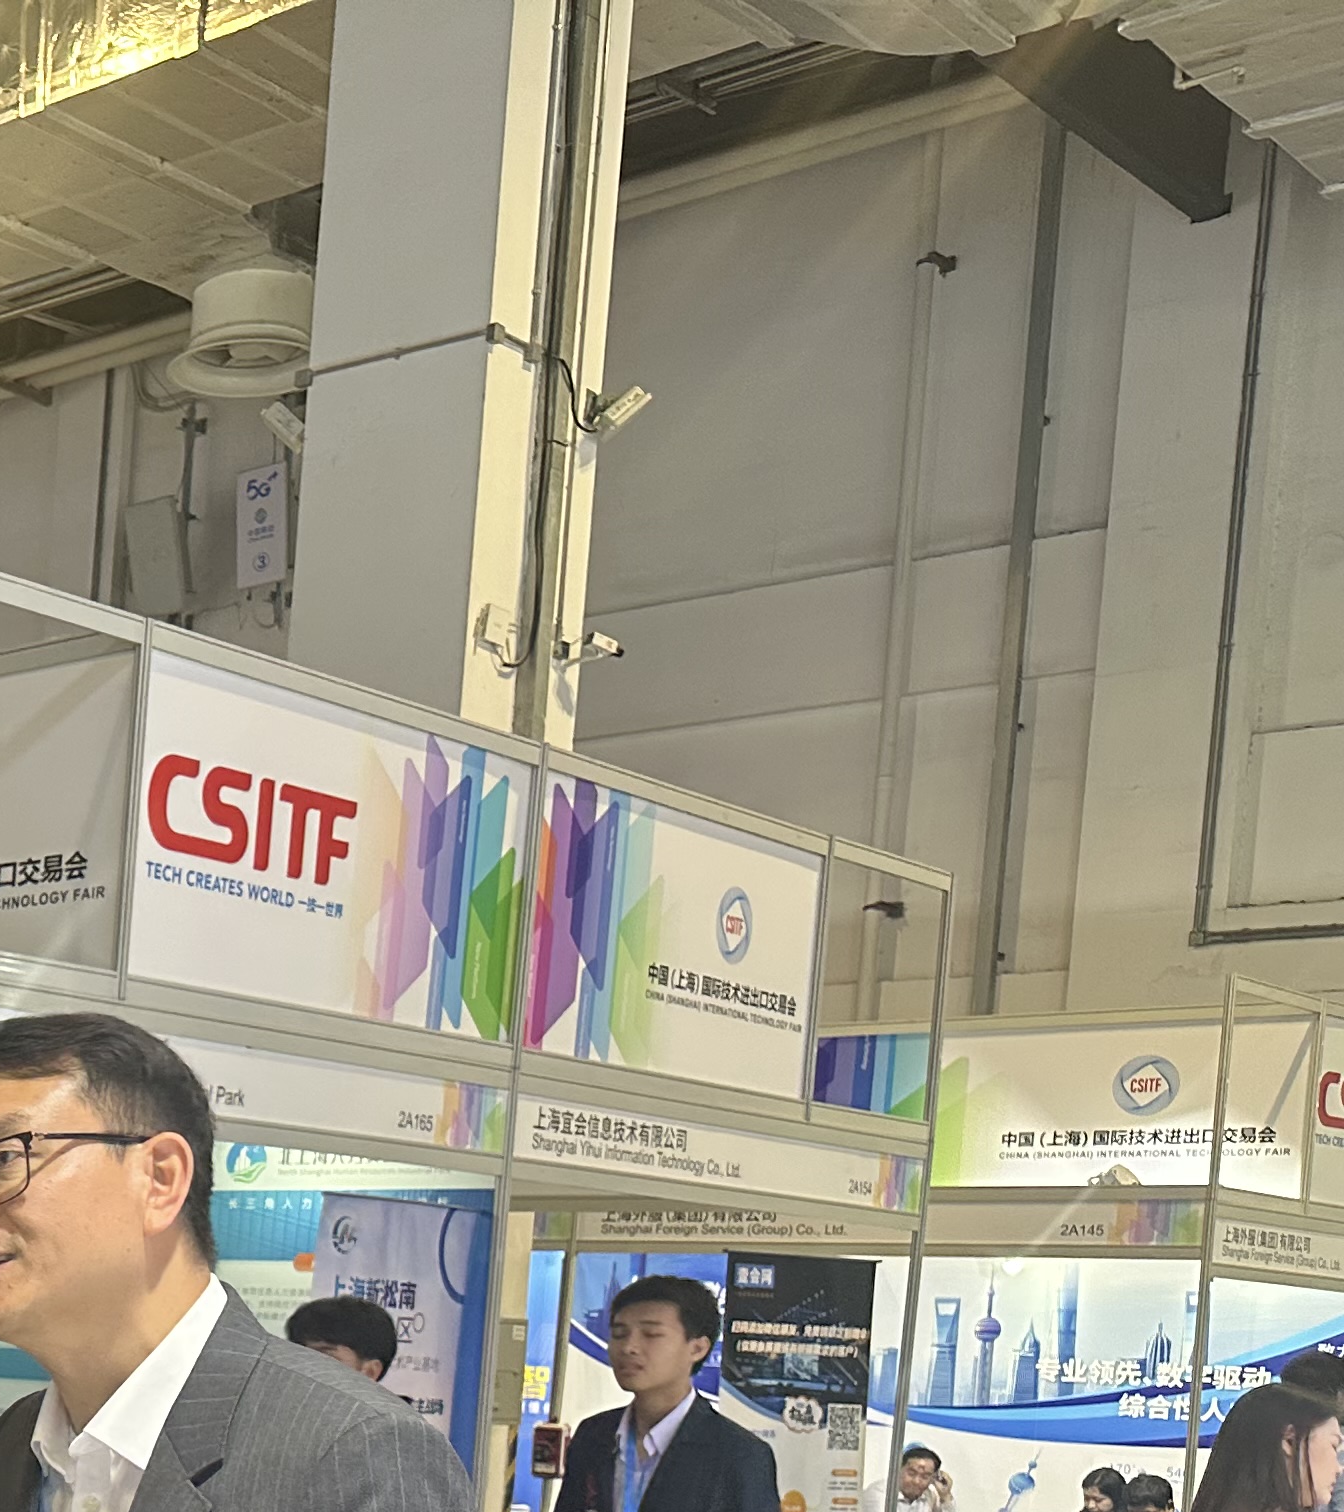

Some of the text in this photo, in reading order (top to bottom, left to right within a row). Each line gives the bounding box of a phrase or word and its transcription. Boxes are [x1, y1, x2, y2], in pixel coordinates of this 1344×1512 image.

[147, 754, 358, 886] CSITF
[72, 885, 106, 901] FAIR
[146, 861, 295, 908] TECH CREATES WORLD
[1129, 1077, 1163, 1095] CSITF
[215, 1088, 245, 1108] Park
[398, 1111, 434, 1132] 2A165
[533, 1106, 688, 1152] 上海宜会信息技术有限公司
[532, 1132, 577, 1157] Shanghai
[581, 1139, 603, 1160] Yihui
[604, 1144, 655, 1166] Information
[657, 1151, 705, 1177] Technology
[999, 1147, 1291, 1161] CHINA (SHANGHAI) INTERNATIONAL TECOLOGY FAIR
[848, 1178, 872, 1196] 2A154
[600, 1224, 653, 1237] Shanghai
[655, 1224, 698, 1237] Foreign
[701, 1224, 744, 1236] Service
[747, 1224, 793, 1238] (Group)
[824, 1225, 847, 1236] Ltd.
[1060, 1224, 1105, 1237] 2A145
[1118, 1392, 1234, 1423] 综合性人
